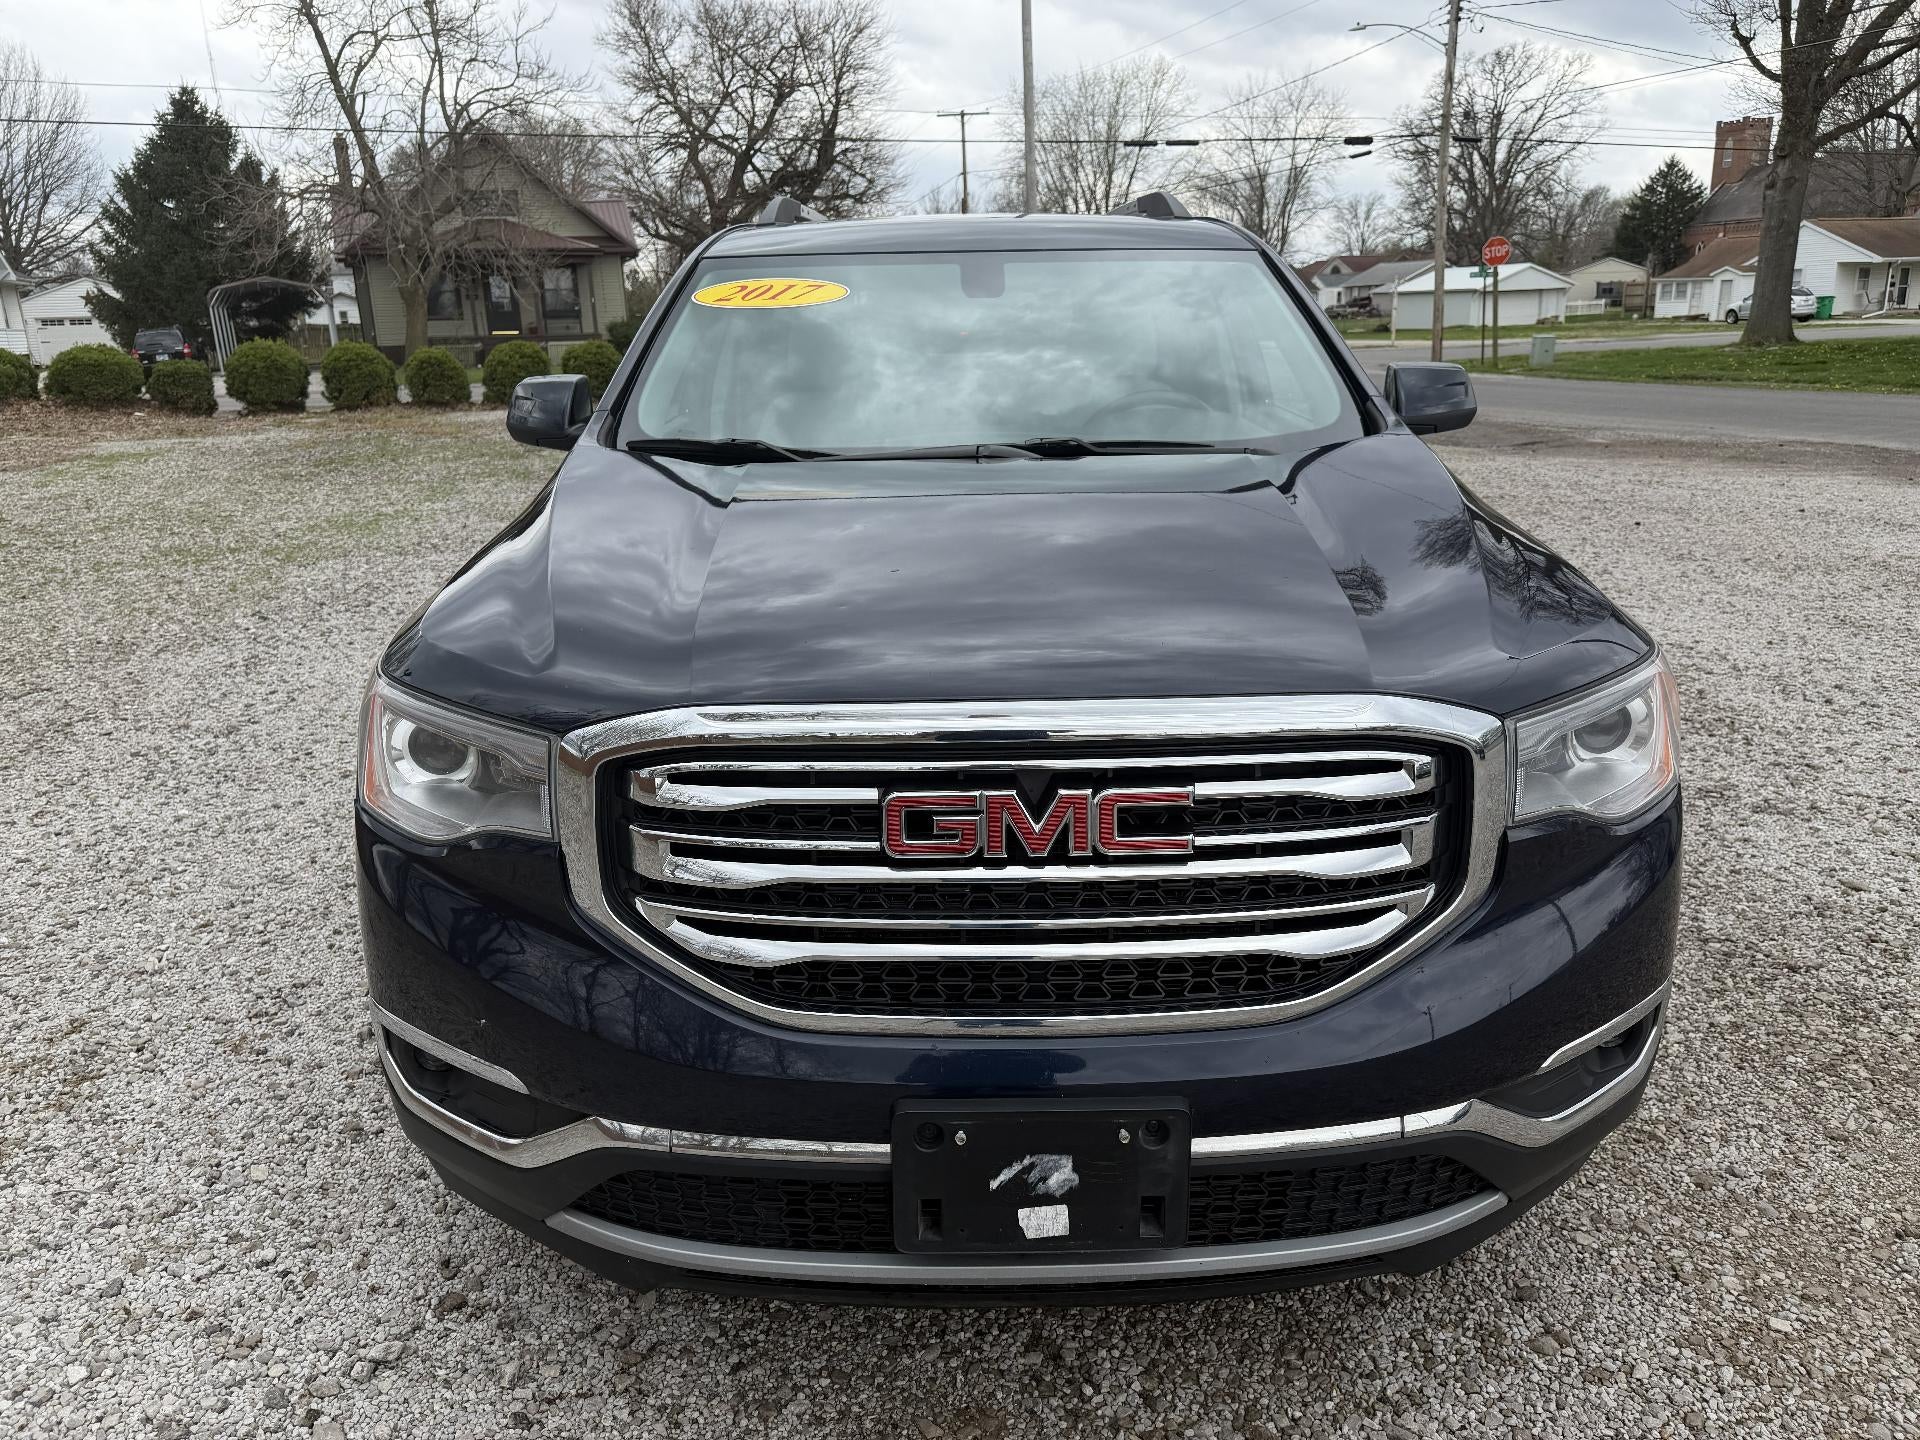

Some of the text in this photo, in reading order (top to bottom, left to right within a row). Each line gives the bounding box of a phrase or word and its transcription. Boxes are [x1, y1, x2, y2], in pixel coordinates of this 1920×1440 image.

[1484, 244, 1508, 259] STOP
[713, 284, 827, 302] 2017
[884, 789, 1194, 858] GMC
